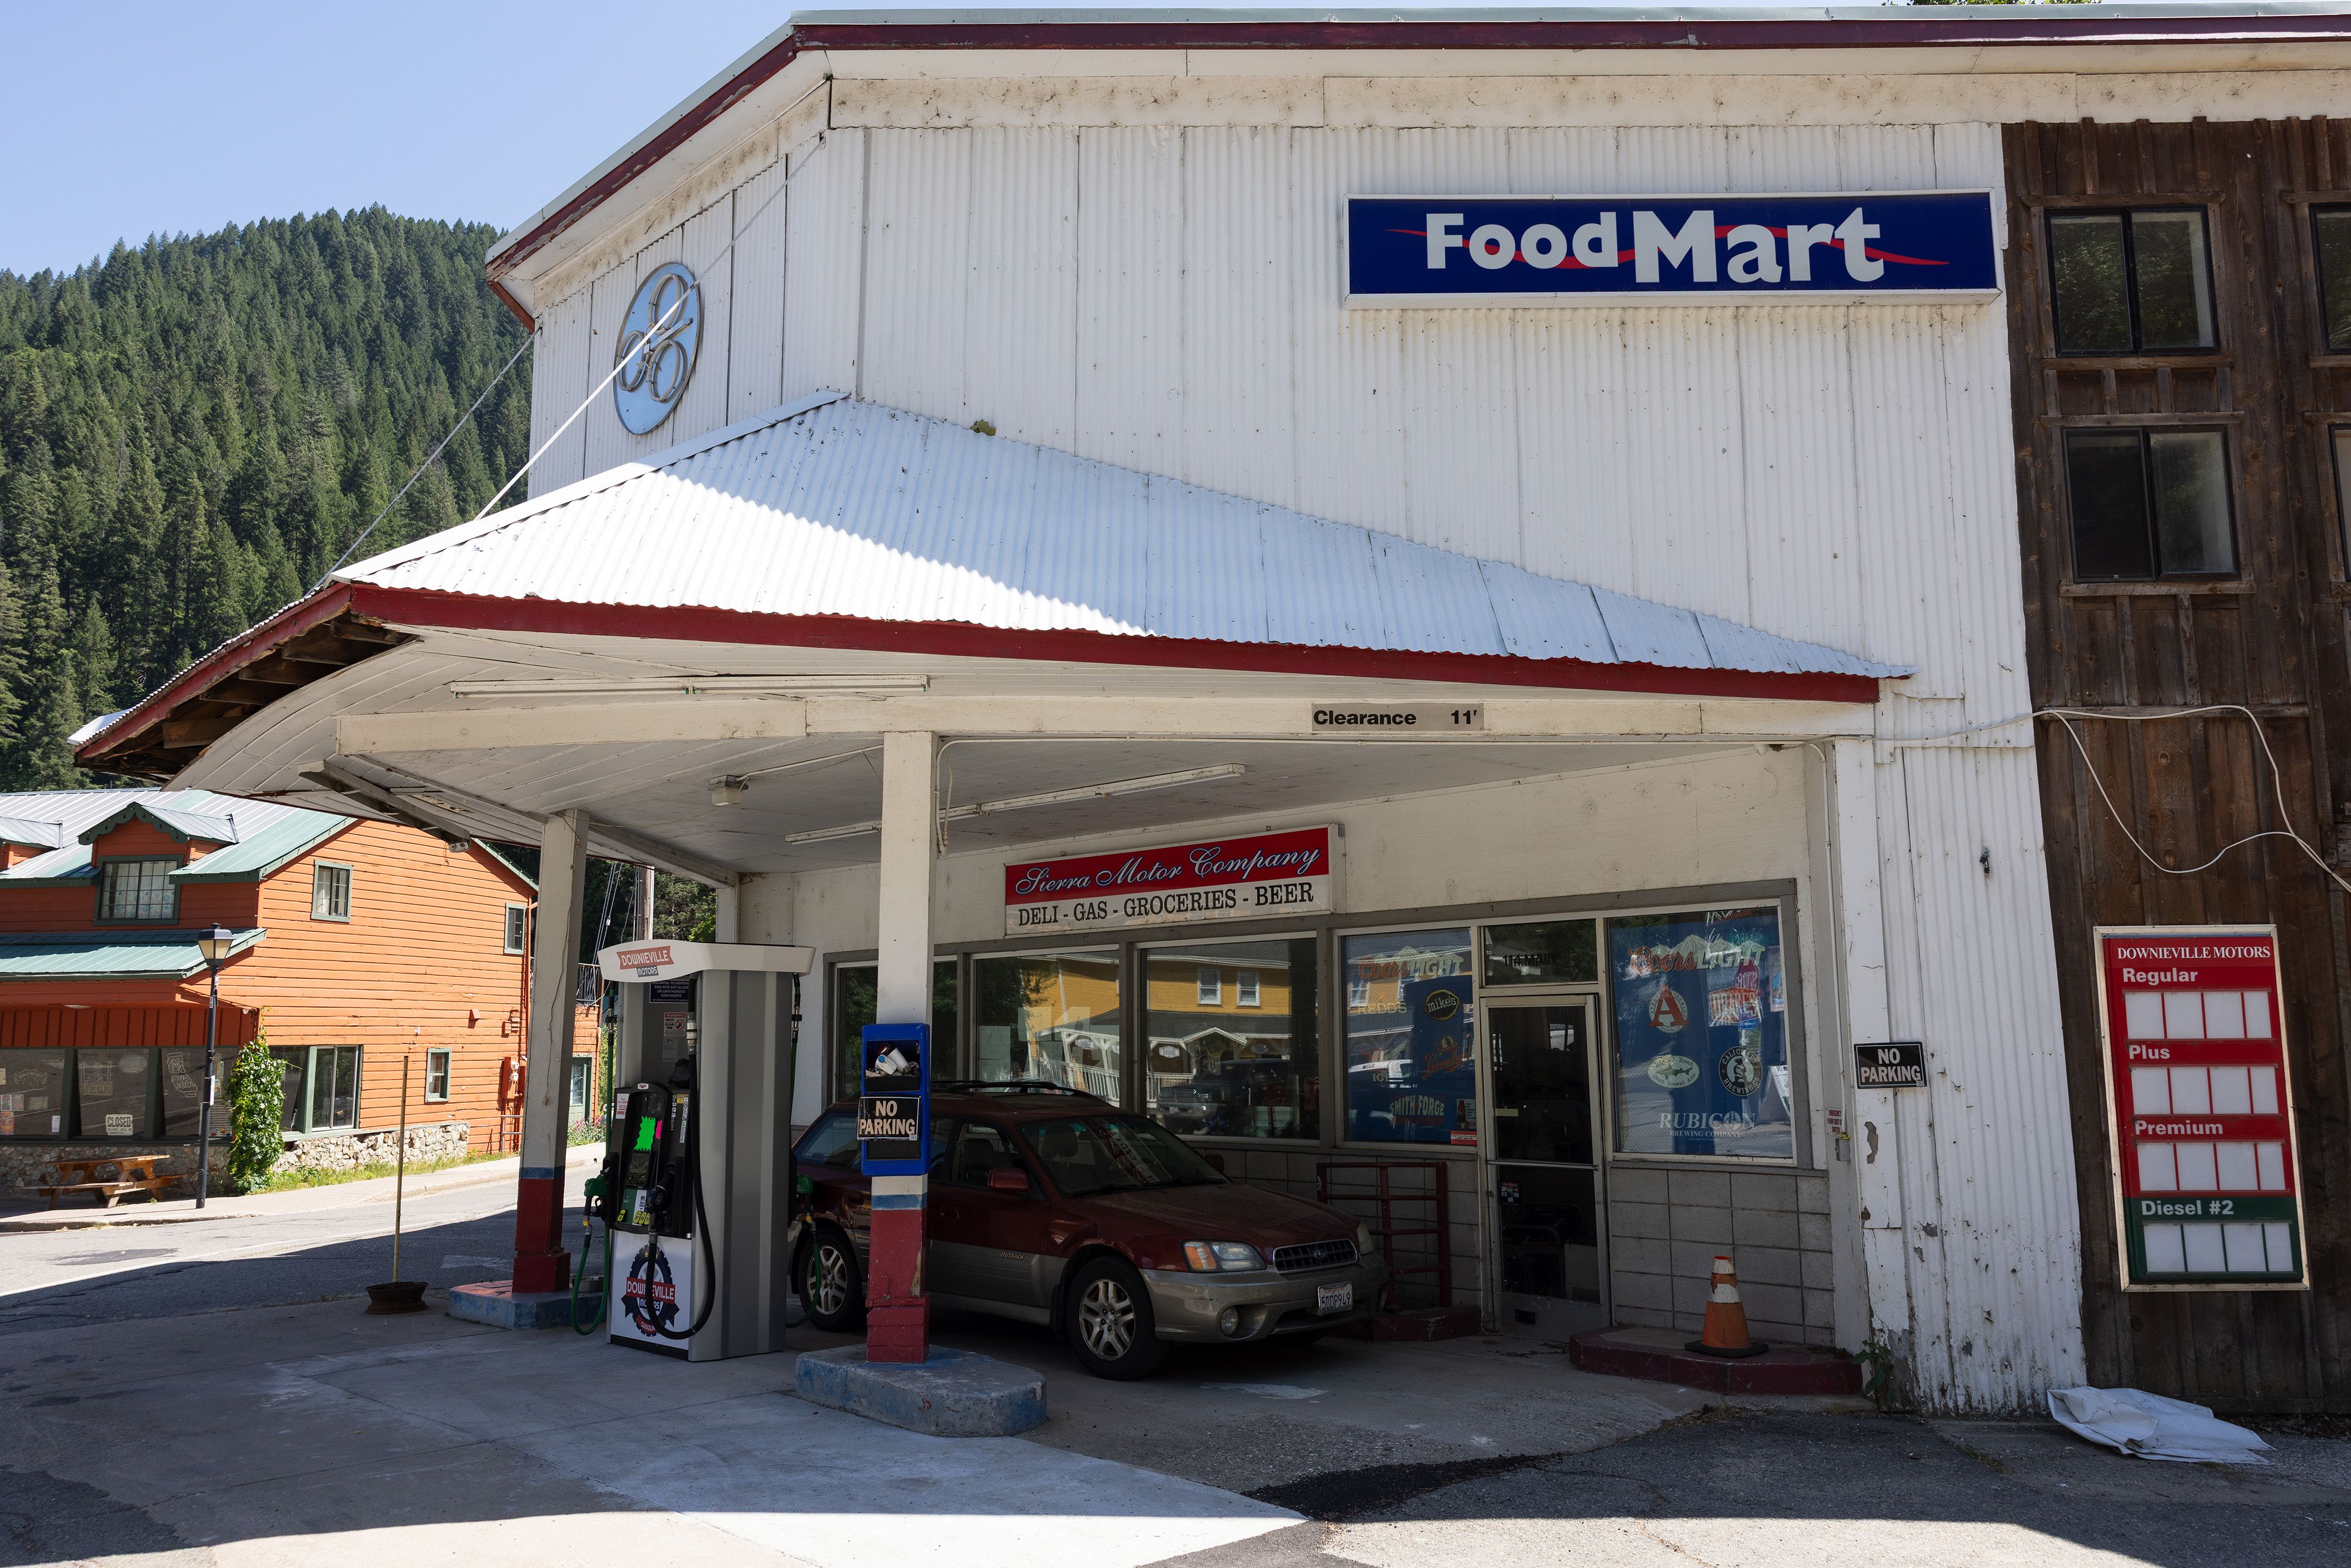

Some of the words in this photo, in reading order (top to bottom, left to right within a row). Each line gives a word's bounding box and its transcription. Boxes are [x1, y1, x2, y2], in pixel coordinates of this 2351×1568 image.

[1313, 710, 1416, 725] Clearance
[1451, 710, 1477, 725] 11'
[1015, 866, 1091, 895] Sierra
[1095, 856, 1183, 887] Motor
[1189, 845, 1321, 880] Company
[1018, 905, 1058, 926] DELI
[1073, 900, 1107, 921] GAS
[1123, 888, 1237, 917] GROCERIES
[1255, 882, 1314, 906] BEER
[621, 950, 669, 966] DOWNIEVILLE
[1503, 954, 1520, 966] 114
[1628, 946, 1696, 974] Coors
[1696, 946, 1766, 969] LIGHT
[2117, 946, 2211, 960] DOWNIEVILLE
[2213, 946, 2270, 959] MOTORS
[637, 966, 658, 976] MOTORS
[1358, 956, 1410, 979] Coors
[1409, 957, 1464, 977] LIGHT
[2122, 968, 2198, 985] Regular
[1427, 995, 1456, 1013] mike's
[1877, 1048, 1901, 1064] NO
[2129, 1045, 2171, 1060] Plus
[1861, 1065, 1922, 1083] PARKING
[1723, 1078, 1754, 1094] BREWING
[875, 1100, 898, 1117] NO
[1389, 1095, 1416, 1115] SMITH
[1417, 1095, 1445, 1115] FORGE
[108, 1116, 131, 1127] CLOSED
[859, 1118, 916, 1135] PARKING
[1659, 1110, 1756, 1130] RUBICON
[2135, 1121, 2223, 1135] Premium
[2141, 1200, 2202, 1216] Diesel
[2209, 1200, 2234, 1215] #2
[1000, 1251, 1025, 1260] OUTBACK
[641, 1321, 657, 1331] GASOLIN
